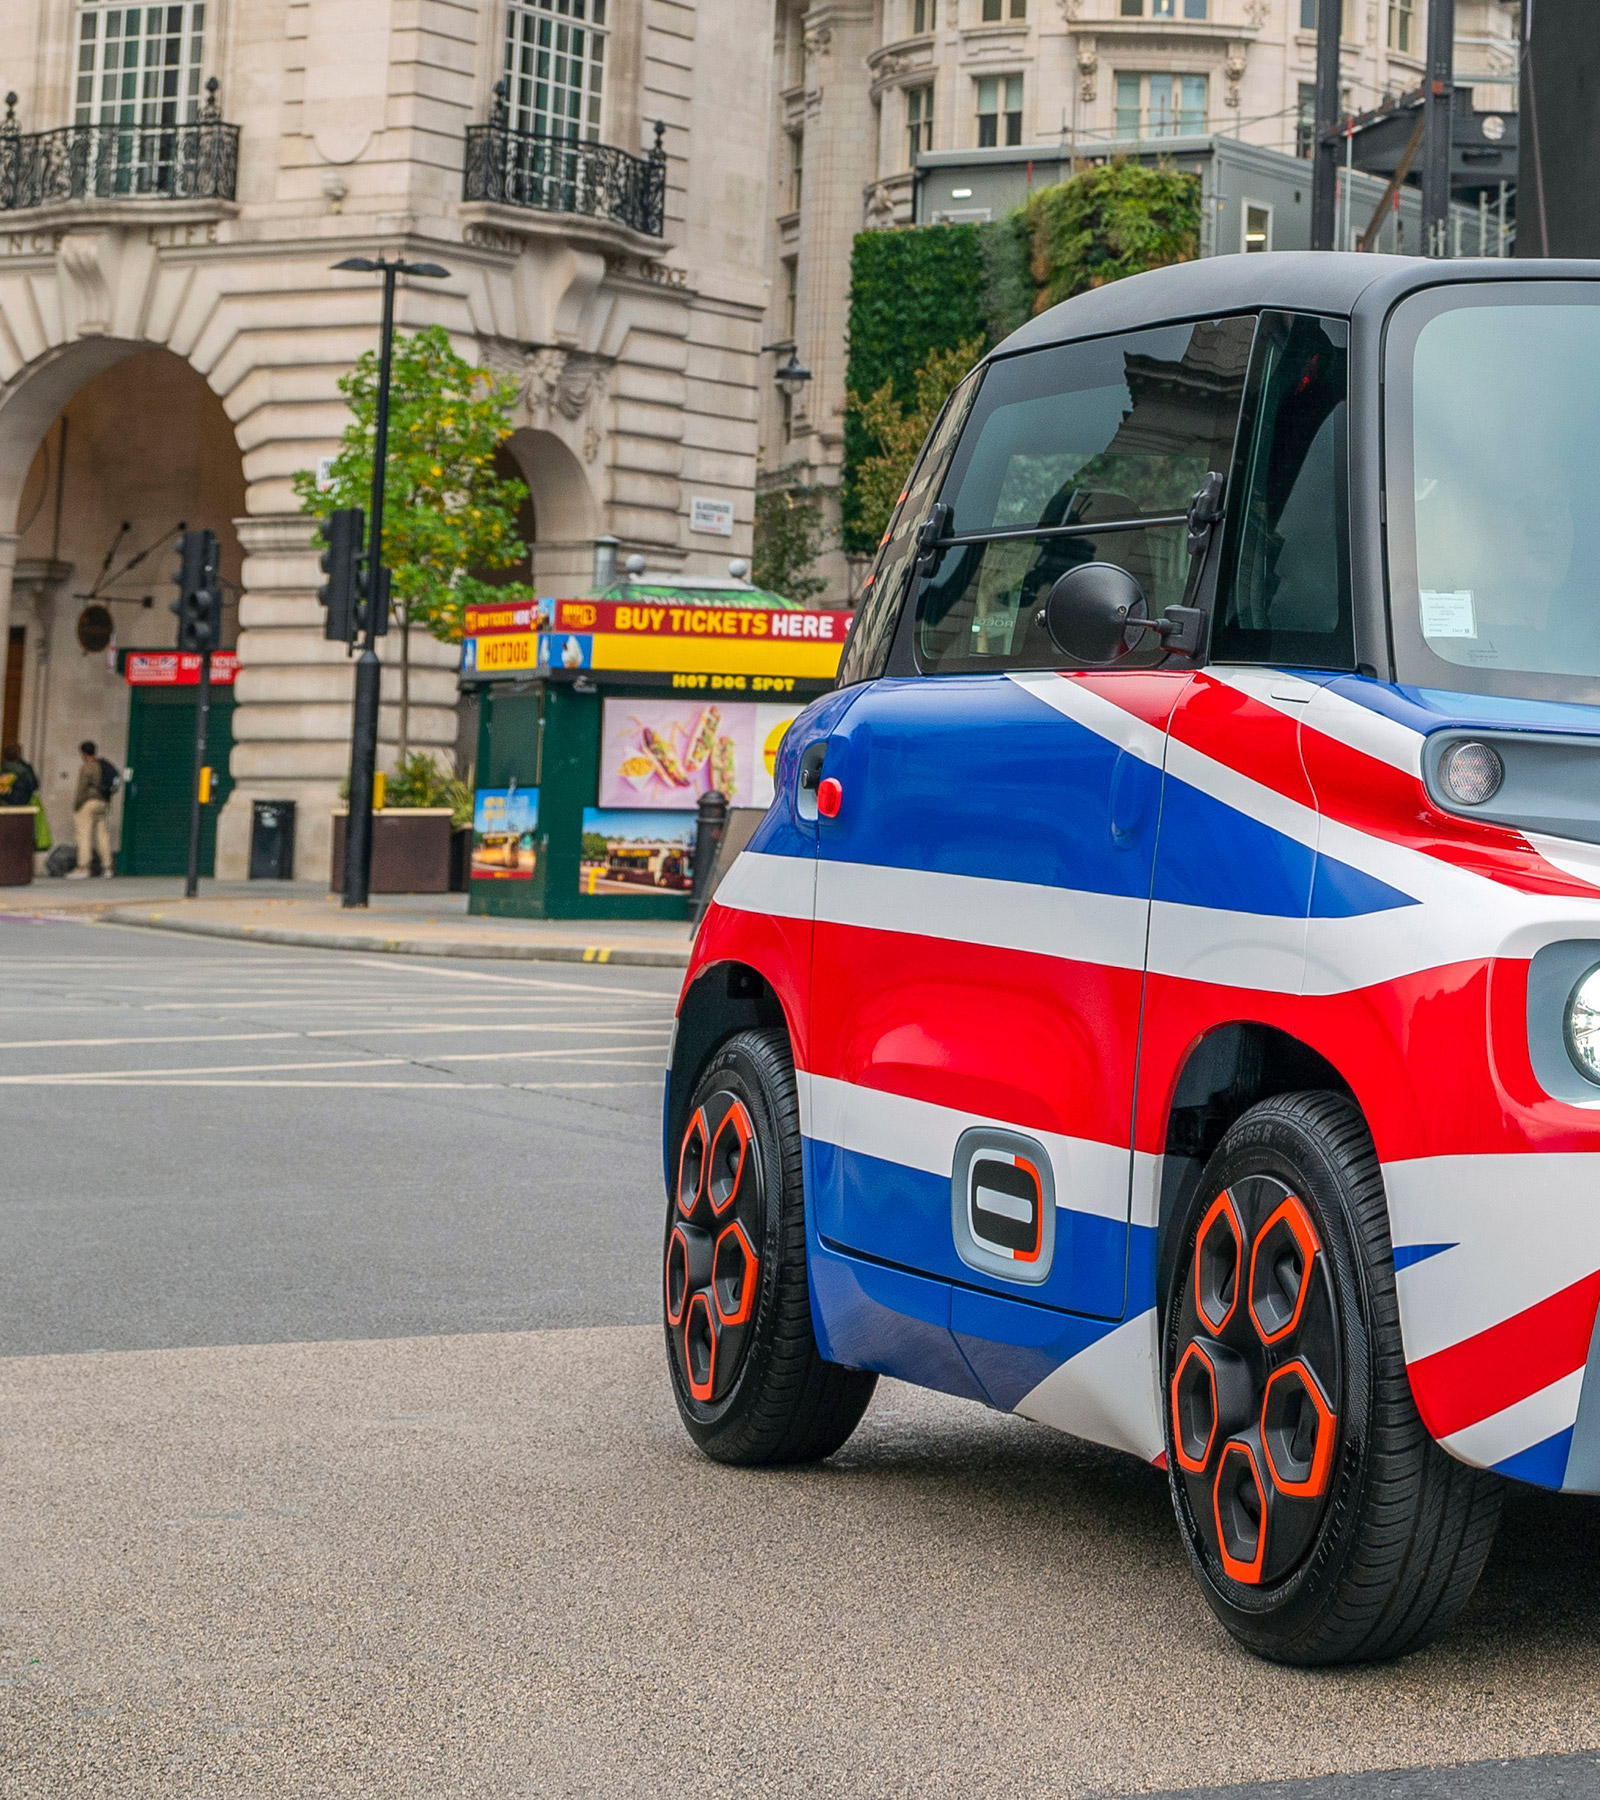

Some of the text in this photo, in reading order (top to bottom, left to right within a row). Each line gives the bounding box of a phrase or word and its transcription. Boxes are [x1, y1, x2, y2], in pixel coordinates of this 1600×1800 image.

[614, 606, 665, 632] BUY
[669, 608, 768, 635] TICKETS
[771, 613, 834, 638] HERE
[672, 674, 795, 692] HOT DOG SPOT
